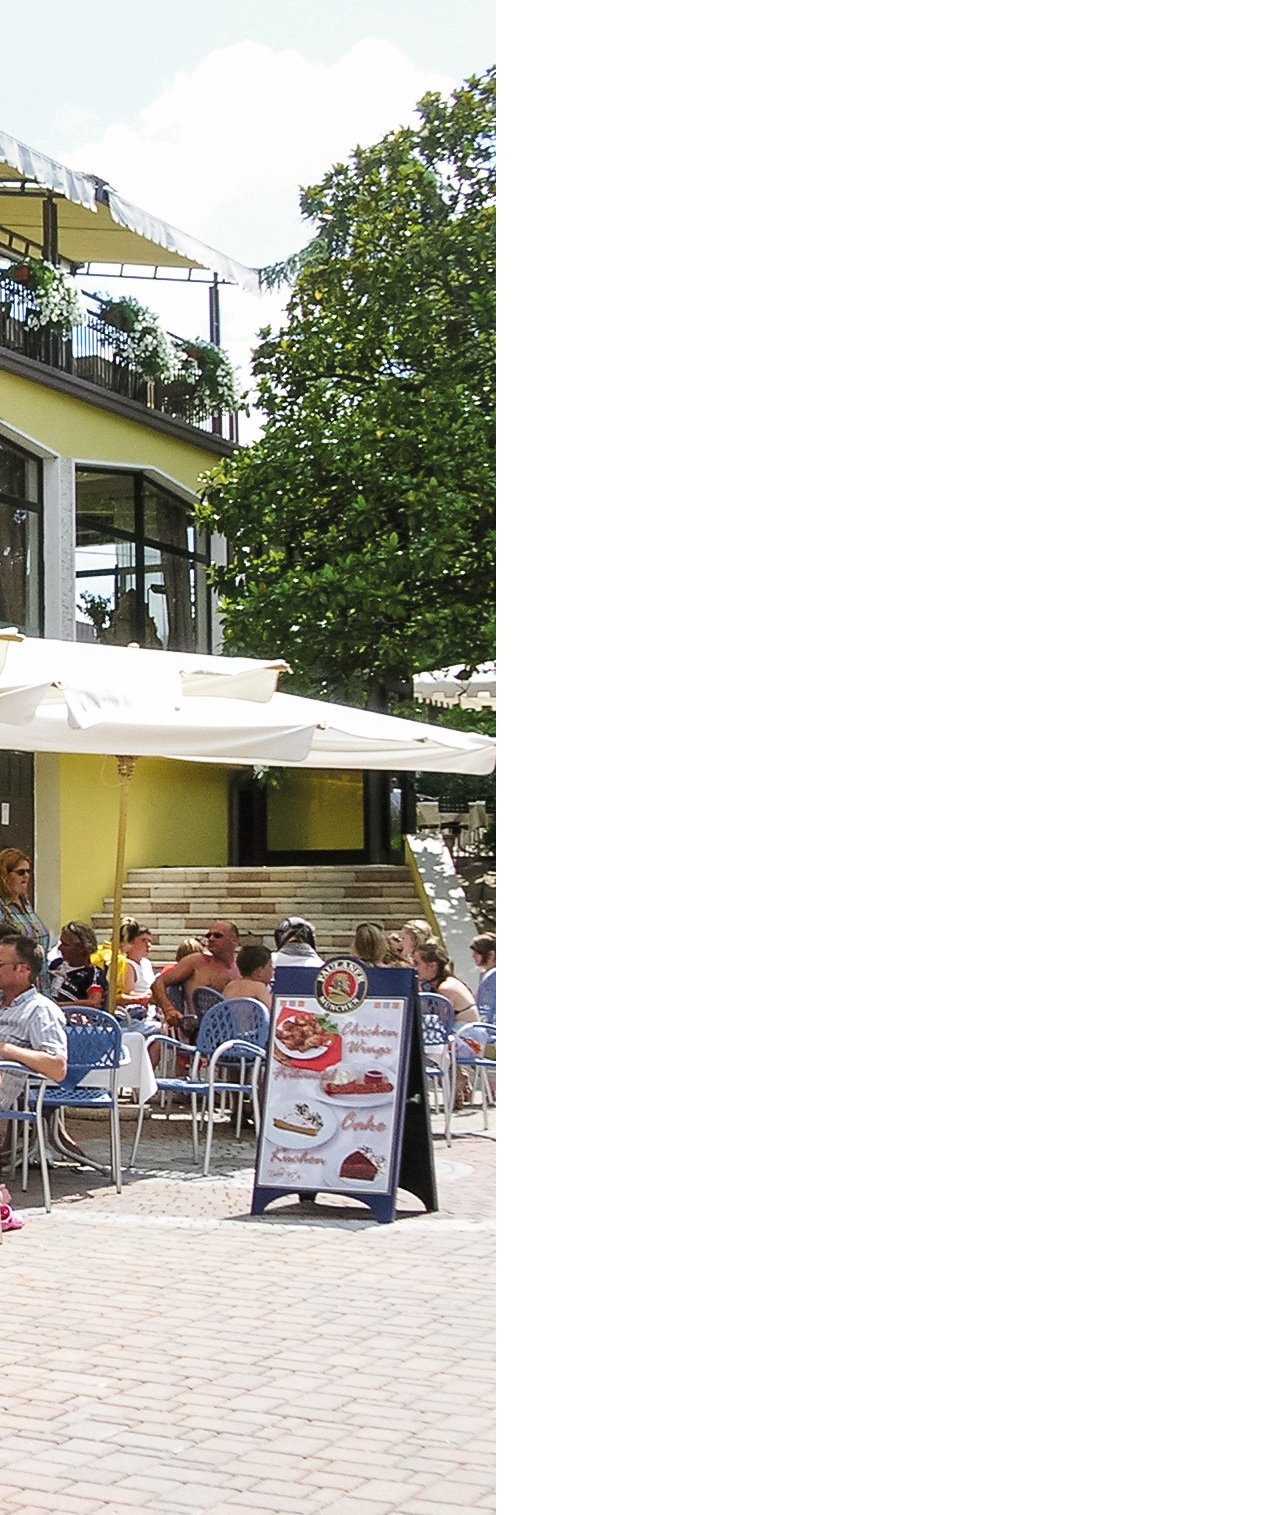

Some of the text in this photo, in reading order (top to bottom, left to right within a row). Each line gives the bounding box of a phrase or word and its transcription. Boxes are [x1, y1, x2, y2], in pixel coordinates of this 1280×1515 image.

[341, 1021, 399, 1038] Chicken
[346, 1039, 393, 1060] Wings
[341, 1110, 387, 1132] Cake
